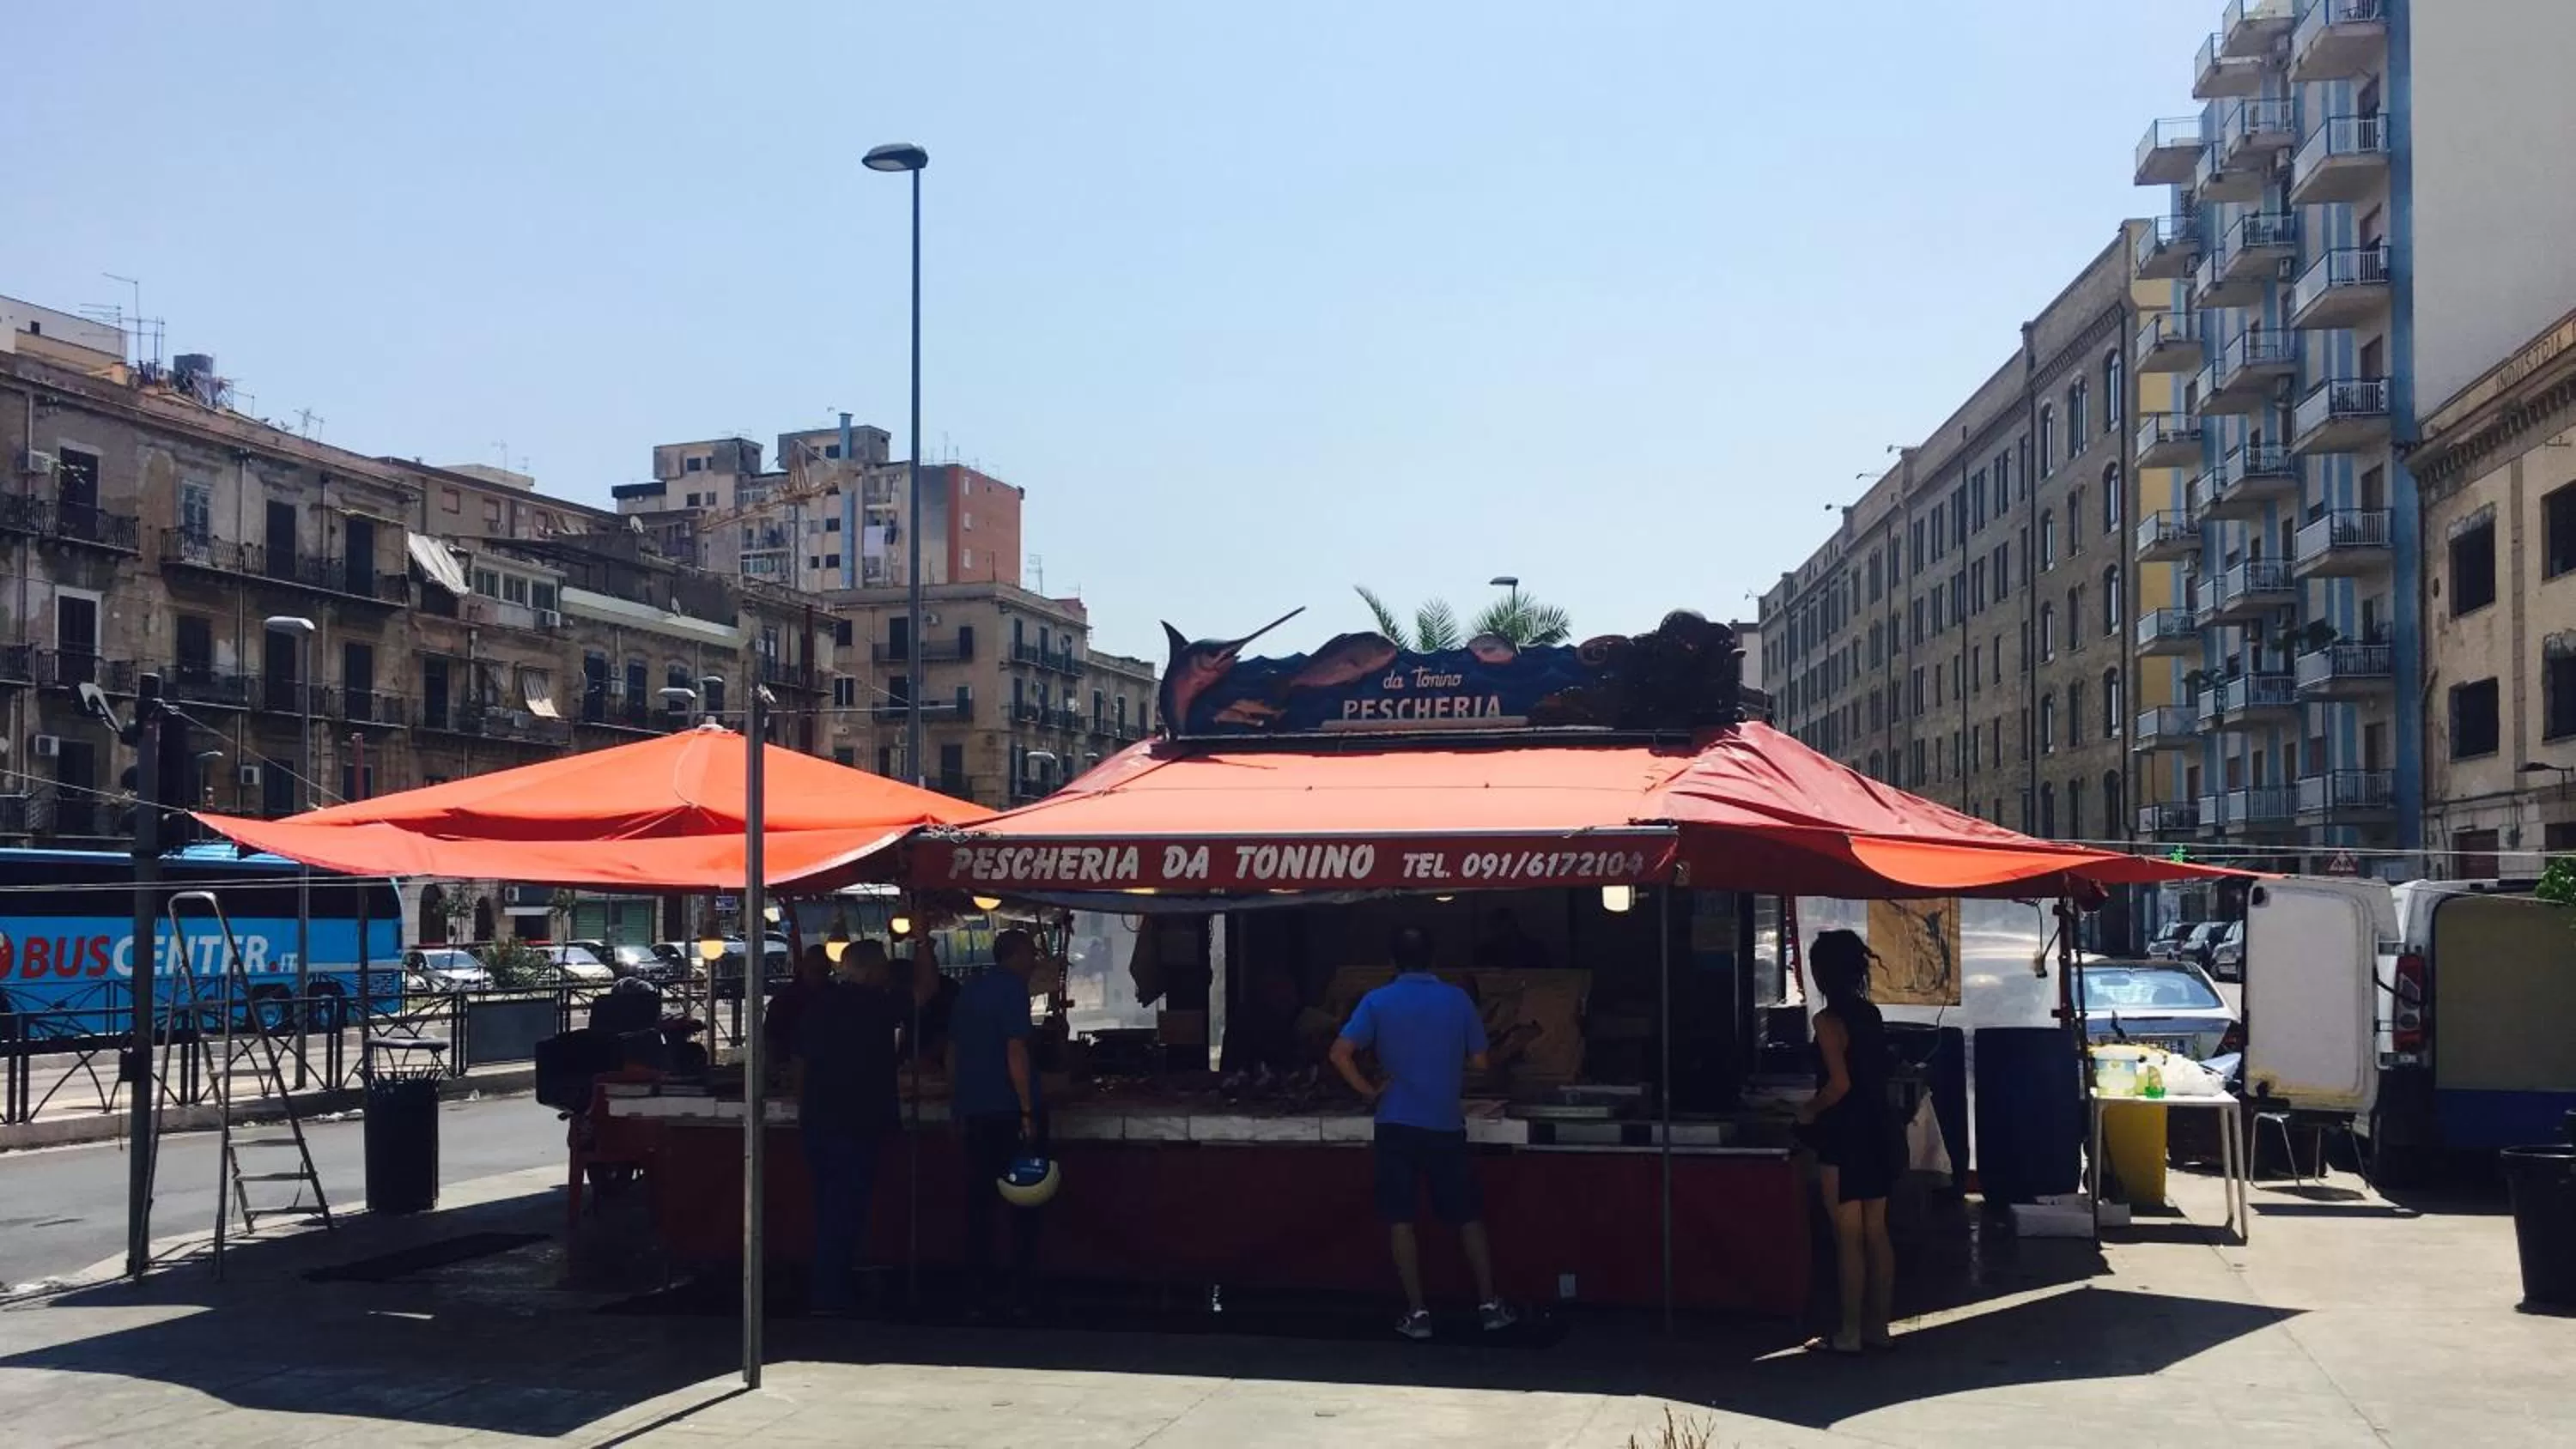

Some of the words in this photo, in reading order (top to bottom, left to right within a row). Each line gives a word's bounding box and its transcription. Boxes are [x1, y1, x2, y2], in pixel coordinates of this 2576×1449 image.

[1383, 671, 1405, 689] da
[1342, 694, 1502, 720] PESCHERIA
[948, 846, 1139, 882] PESCHERIA
[1162, 846, 1210, 880] DA
[1236, 844, 1375, 880] TONINO
[1402, 852, 1451, 878] TEL.
[1461, 851, 1644, 880] 091/6172104
